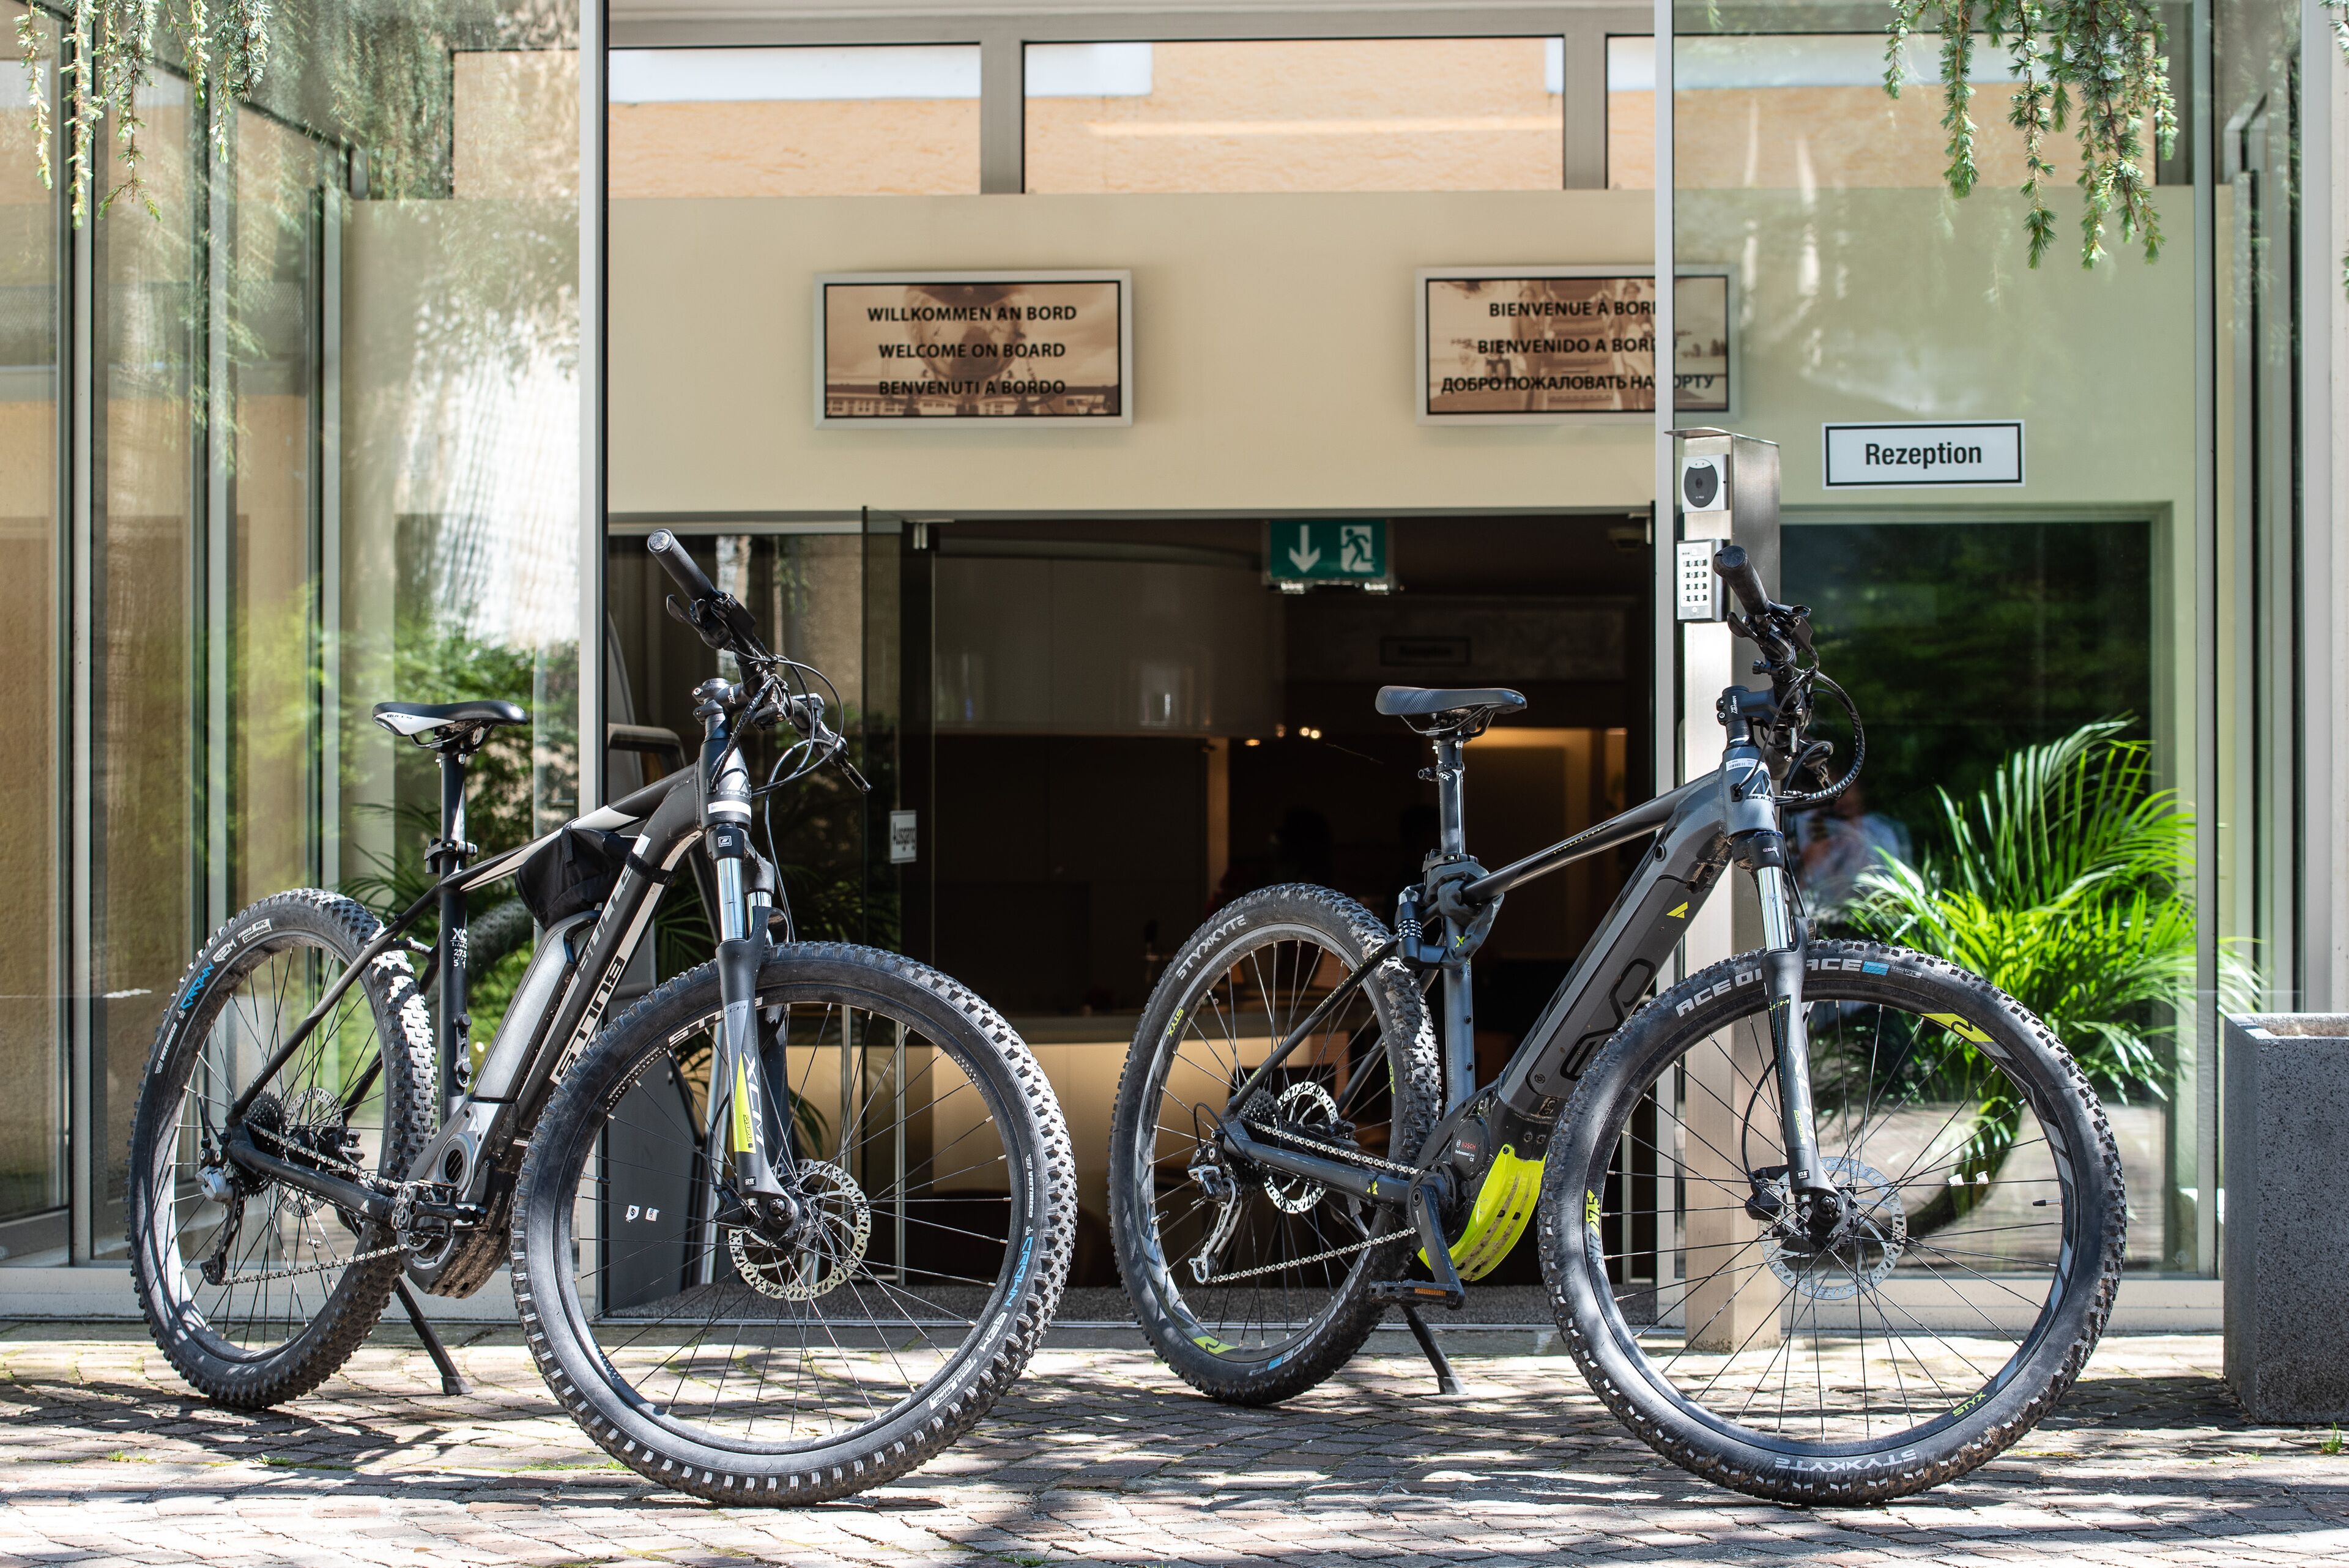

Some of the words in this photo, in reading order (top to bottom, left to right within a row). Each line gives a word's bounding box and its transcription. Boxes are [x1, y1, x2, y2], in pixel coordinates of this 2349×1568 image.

[867, 307, 992, 322] WILLKOMMEN
[996, 307, 1022, 321] AN
[1027, 306, 1077, 321] BORD
[1489, 302, 1592, 318] BIENVENUE
[878, 343, 967, 359] WELCOME
[971, 343, 998, 358] ON
[1003, 343, 1066, 357] BOARD
[1478, 339, 1589, 354] BIENVENIDO
[1594, 339, 1607, 352] A
[879, 381, 979, 395] BENVENUTI
[985, 381, 998, 395] A
[1001, 381, 1066, 395] BORDO
[1441, 377, 1505, 395] ДОБРО
[1505, 375, 1626, 392] ПОЖАЛОВАТЬ
[1631, 375, 1655, 390] НА
[1674, 374, 1715, 389] ОРТУ
[1865, 442, 1982, 469] Rezeption
[180, 961, 215, 1011] CROWN
[1676, 979, 1732, 1017] ACE
[1806, 958, 1861, 972] ACE
[555, 959, 627, 1079] BULLS
[1167, 1008, 1184, 1037] STYX
[744, 1052, 763, 1145] XCM
[1791, 1045, 1817, 1144] XCM
[1005, 1236, 1034, 1307] CROWN
[1280, 1318, 1327, 1362] PACE
[1953, 1392, 1986, 1417] STYX
